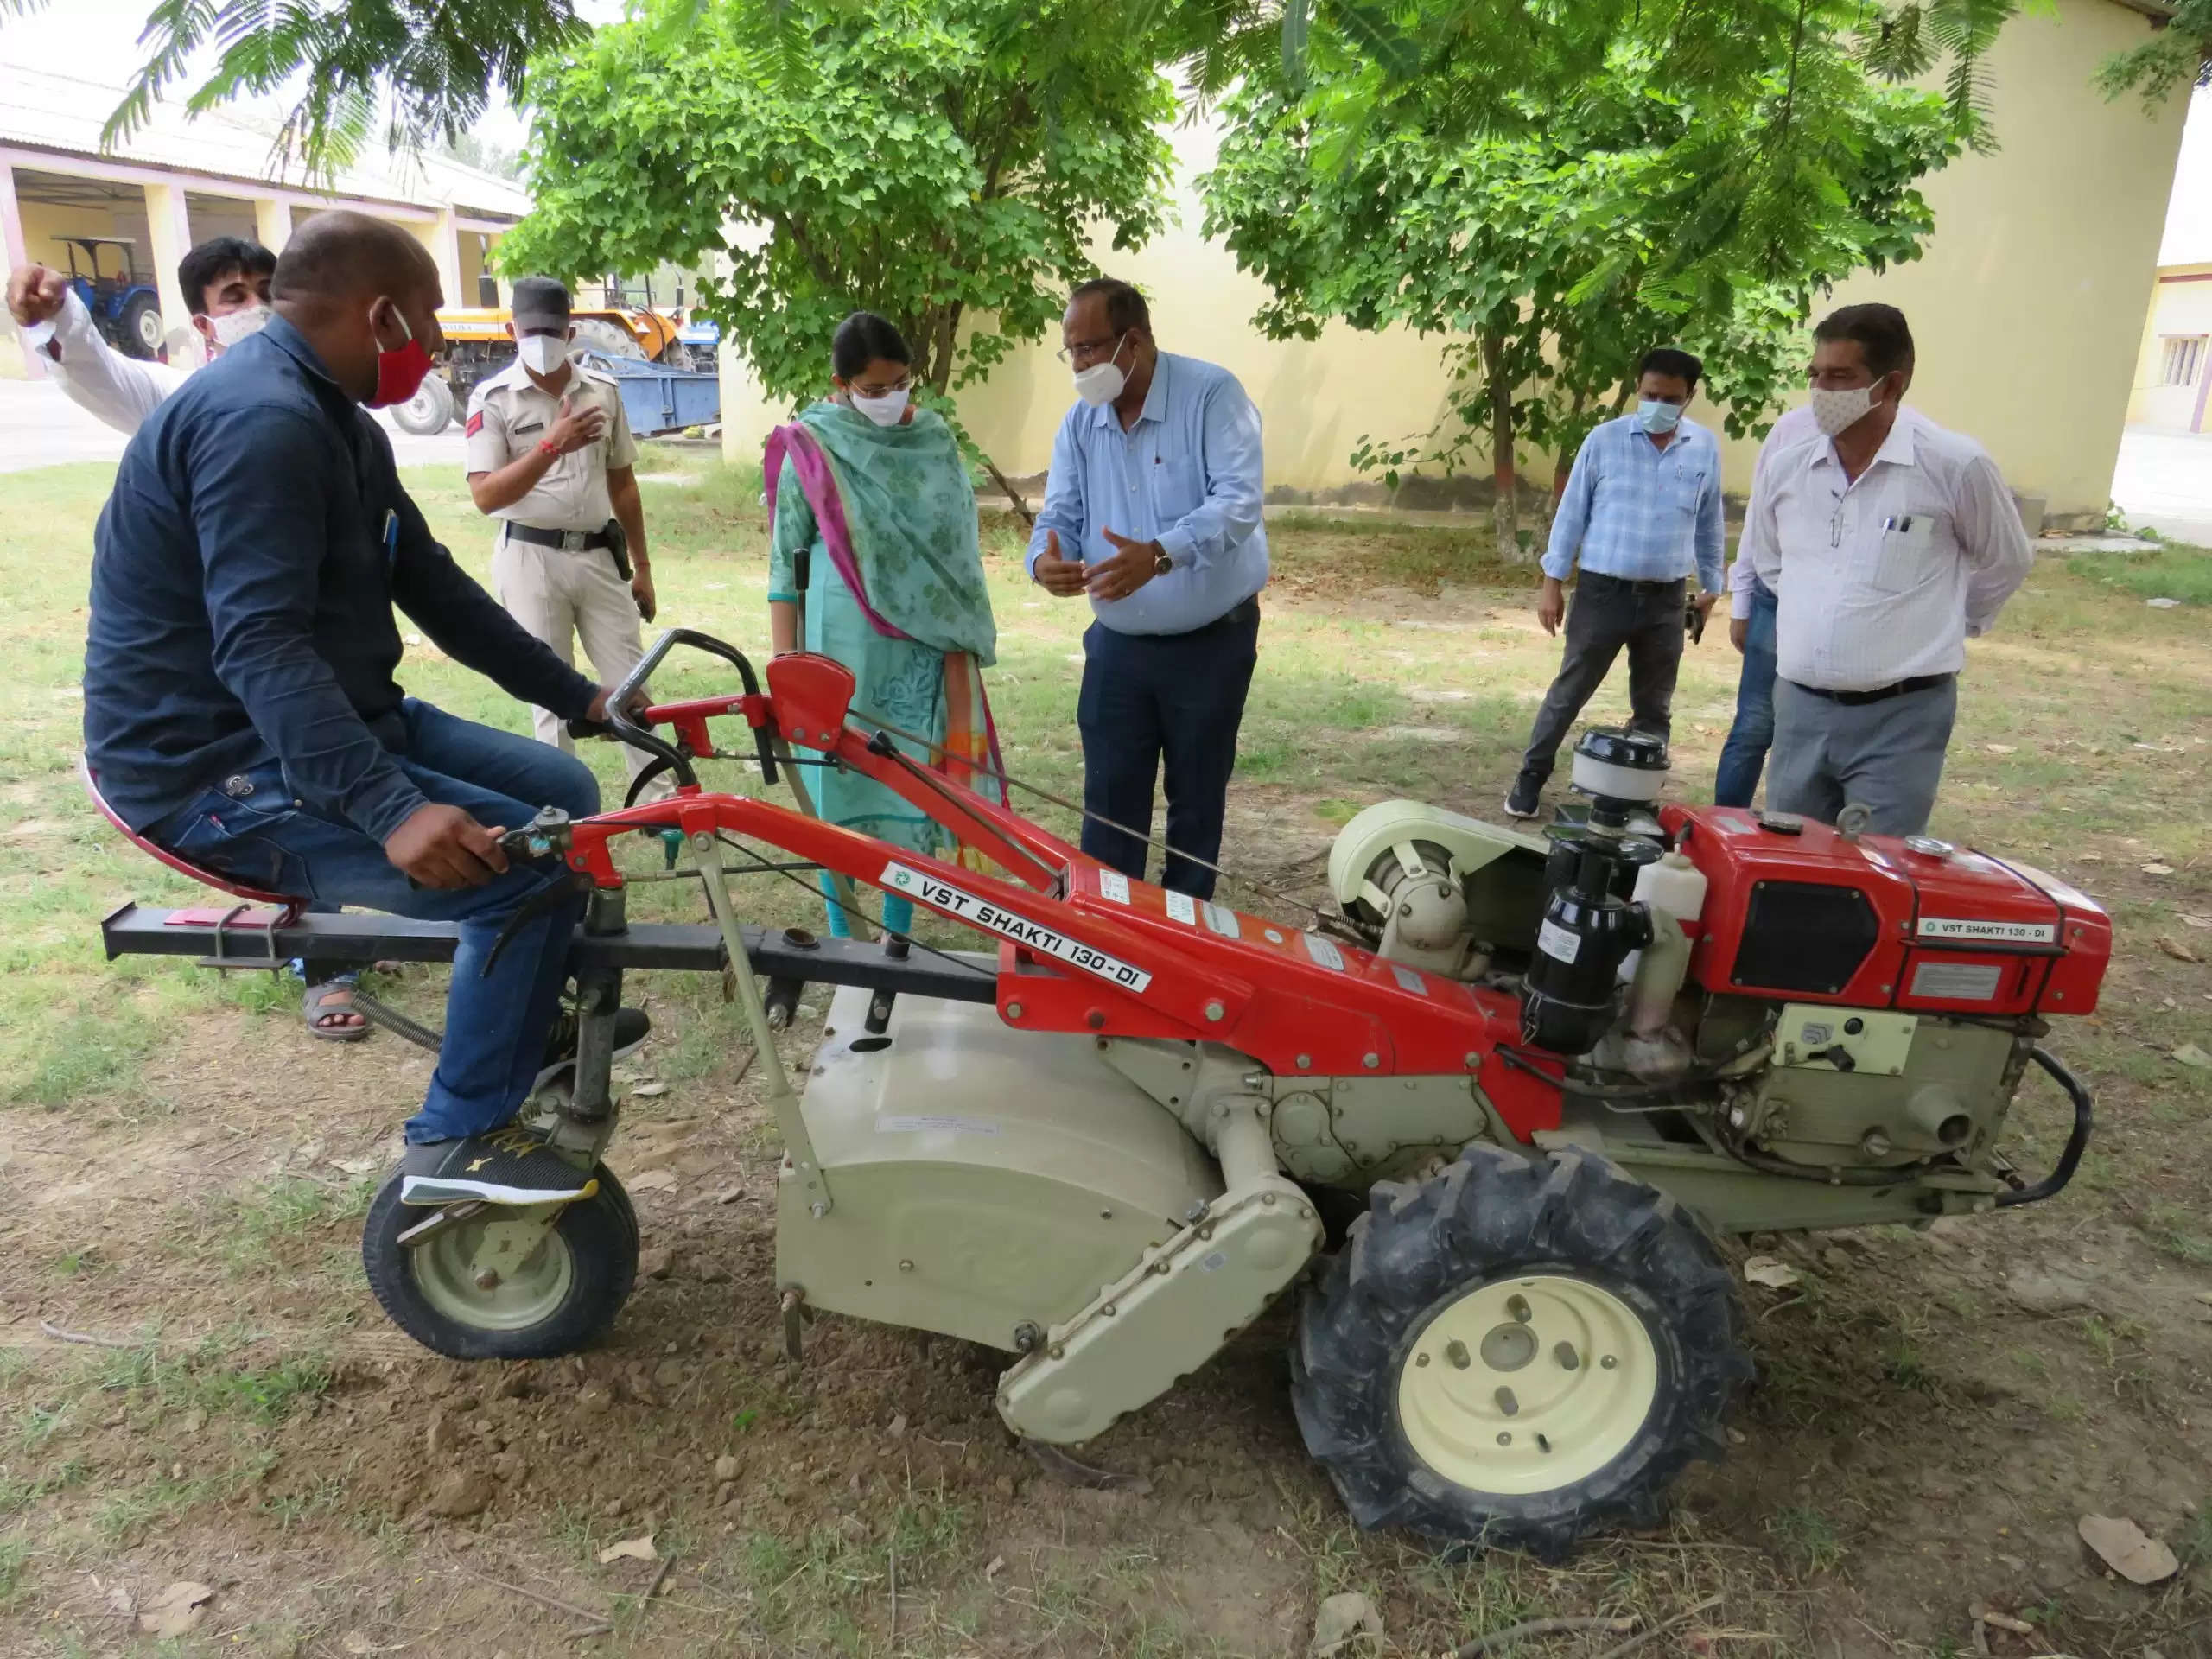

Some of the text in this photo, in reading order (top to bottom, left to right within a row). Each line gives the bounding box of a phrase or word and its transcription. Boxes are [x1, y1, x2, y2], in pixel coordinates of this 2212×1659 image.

[922, 881, 969, 911] VST
[977, 907, 1063, 951] SHAKTI
[1942, 924, 1963, 933] VST
[1966, 925, 2005, 935] SHAKTI
